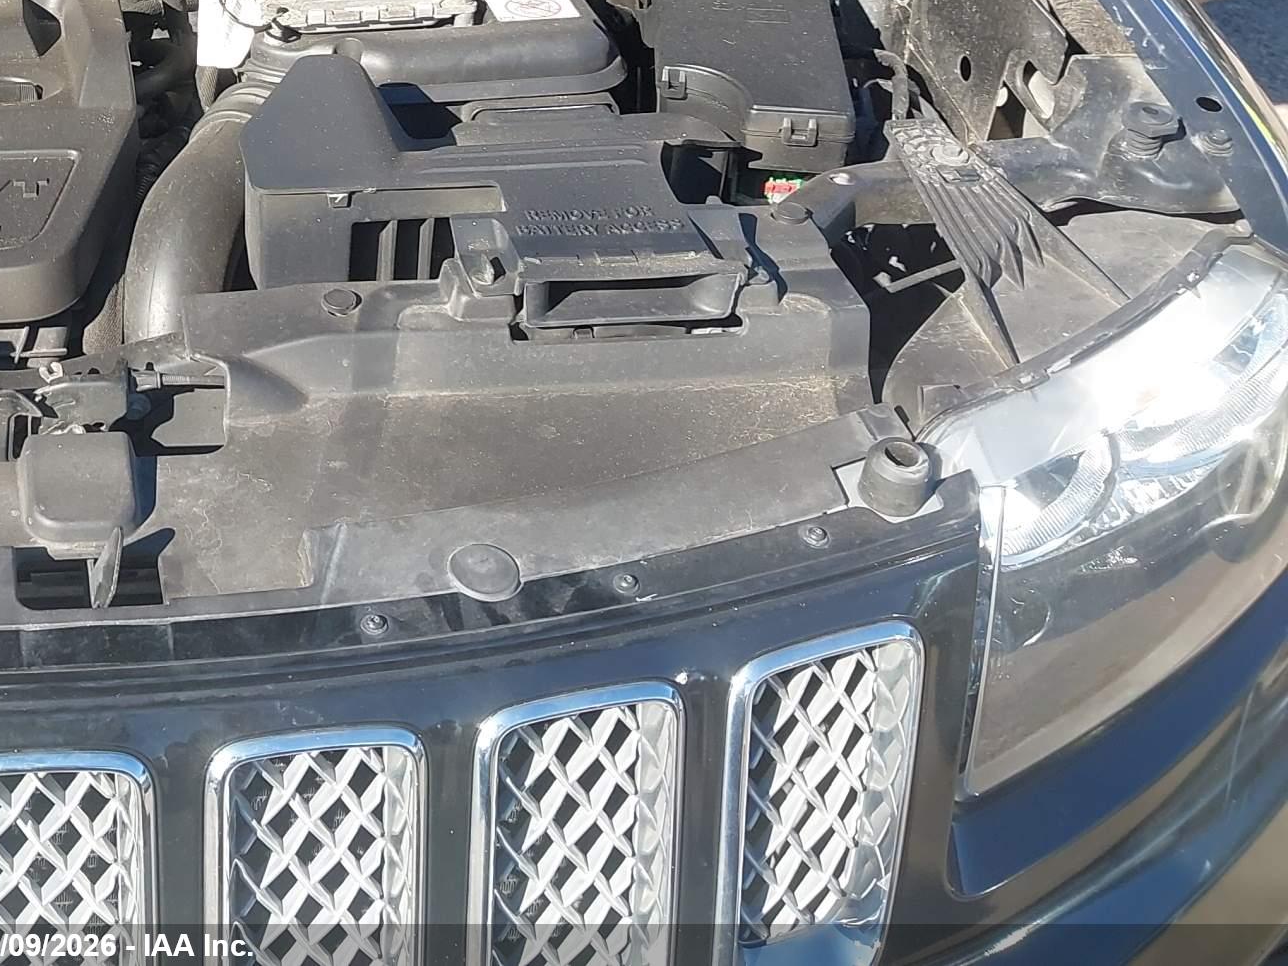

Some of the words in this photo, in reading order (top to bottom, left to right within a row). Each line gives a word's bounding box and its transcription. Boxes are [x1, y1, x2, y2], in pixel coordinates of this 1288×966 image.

[523, 208, 610, 222] REMOVE
[615, 205, 655, 219] FOR
[515, 223, 601, 236] BATTERY
[606, 218, 685, 235] ACCESS
